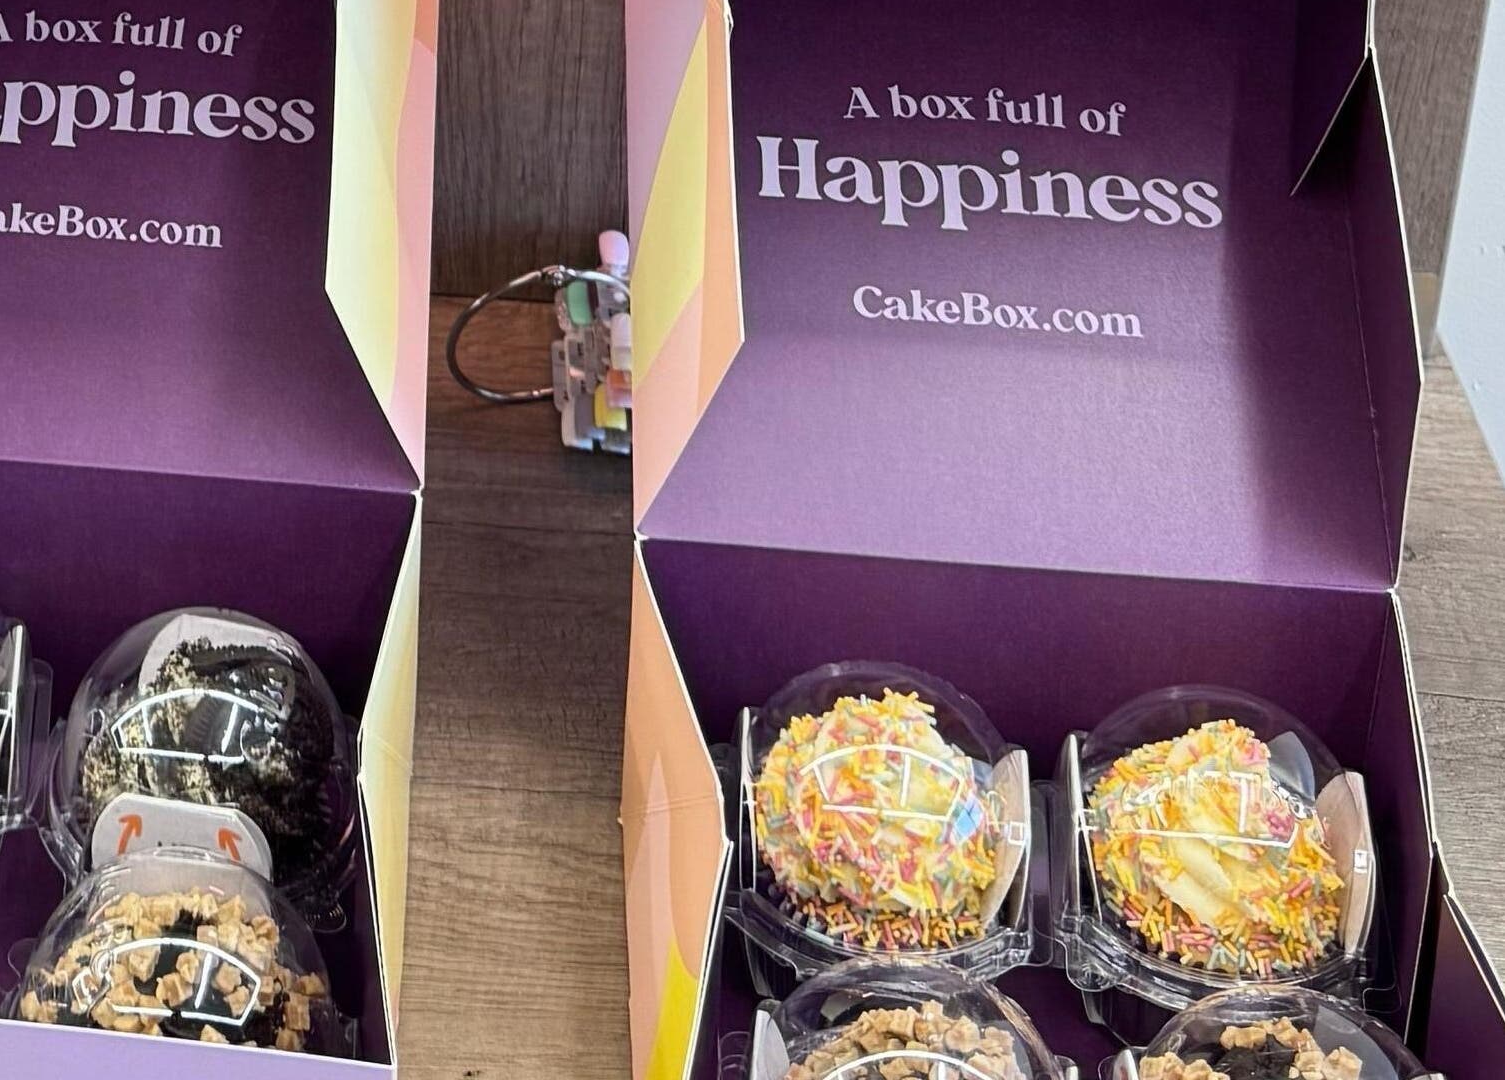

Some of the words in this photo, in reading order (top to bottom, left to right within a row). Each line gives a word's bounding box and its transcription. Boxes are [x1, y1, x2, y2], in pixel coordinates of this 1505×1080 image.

[25, 10, 102, 43] box
[111, 12, 186, 50] full
[197, 24, 243, 56] of
[843, 86, 880, 120] A
[887, 84, 975, 121] box
[986, 87, 1066, 129] full
[1079, 102, 1127, 137] of
[756, 135, 1223, 231] Happiness
[852, 285, 1144, 339] CakeBox.com
